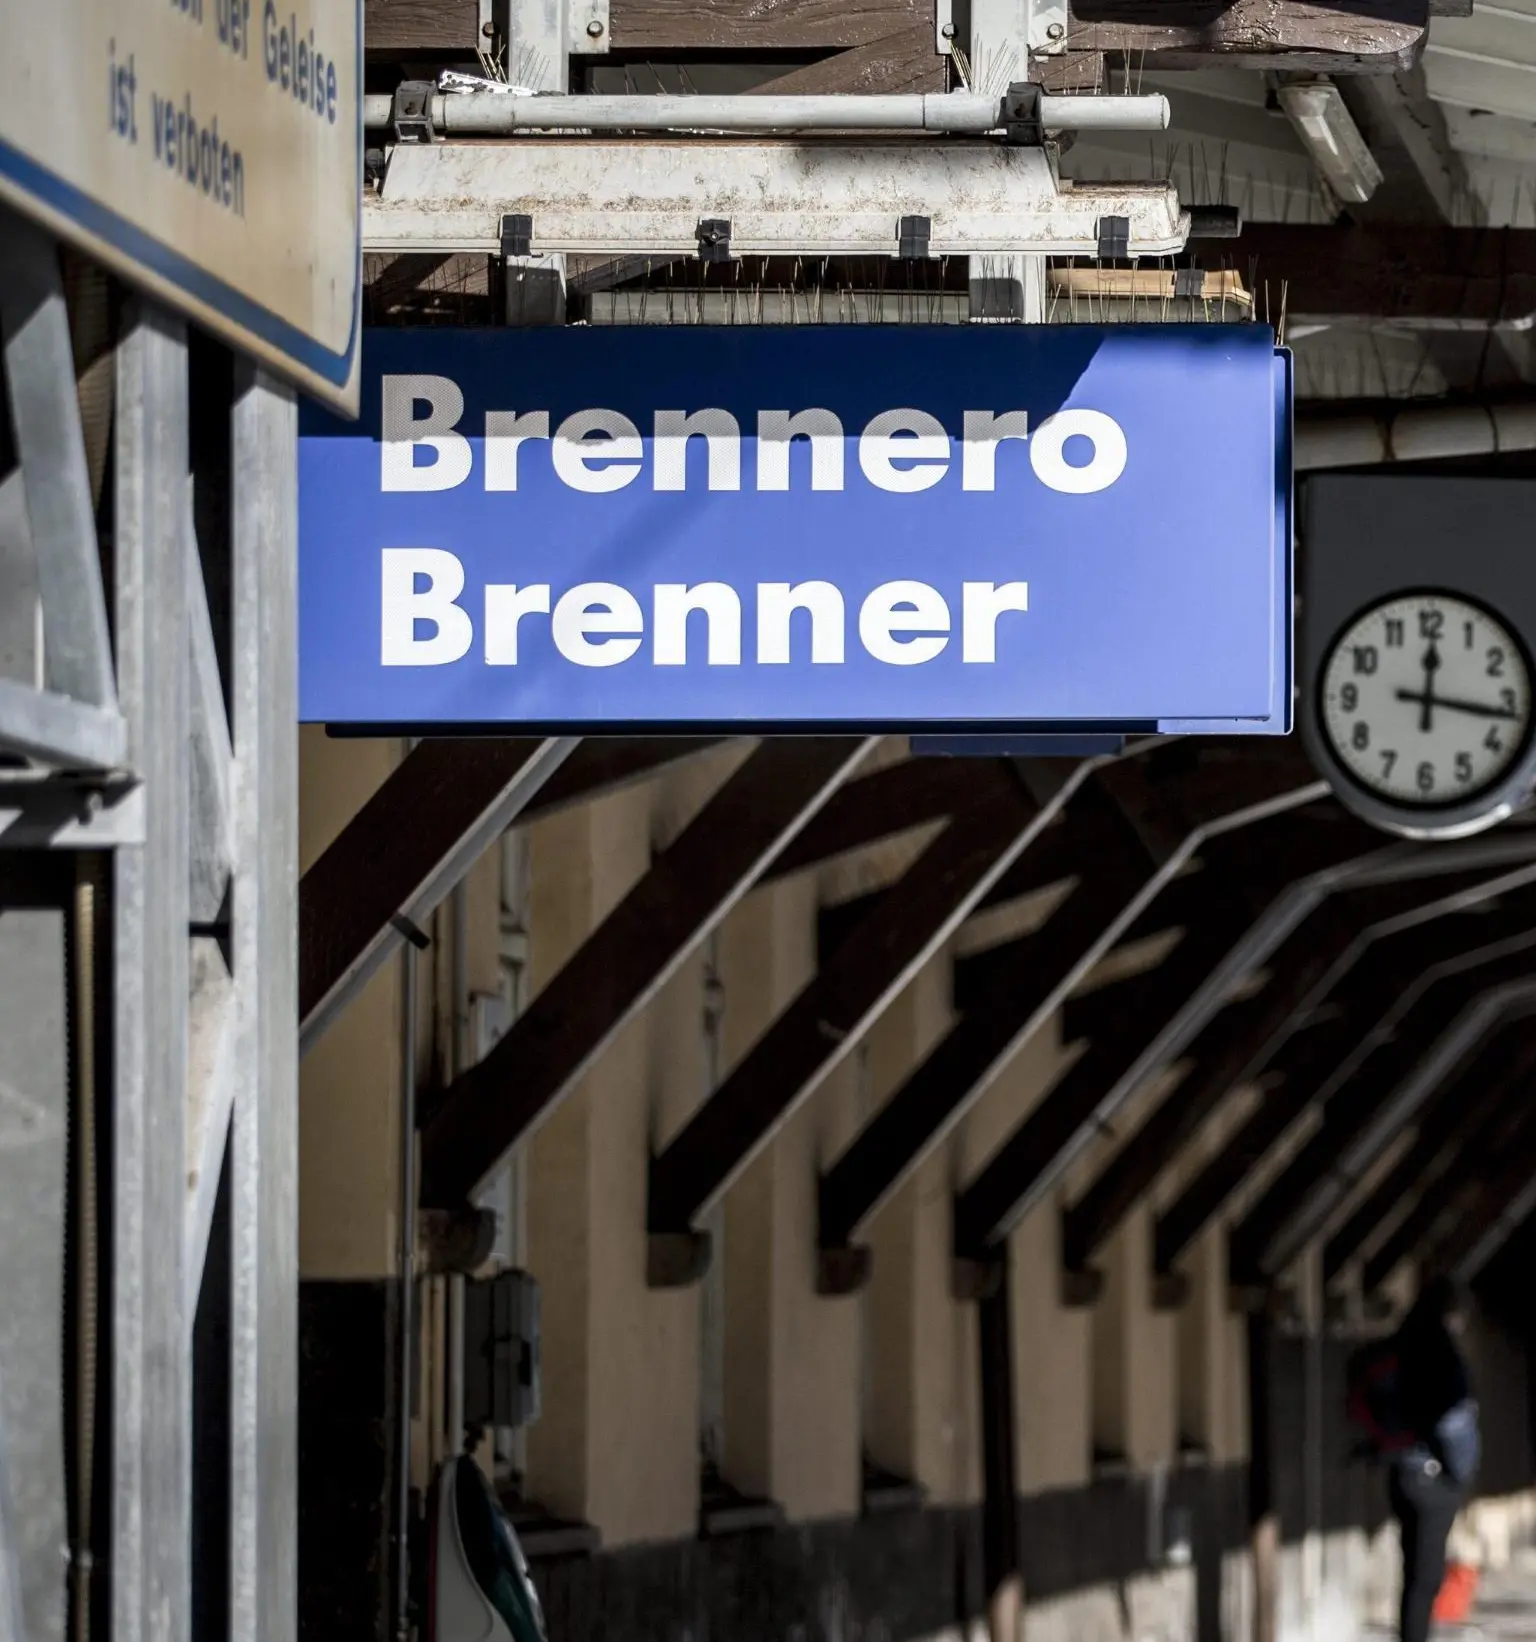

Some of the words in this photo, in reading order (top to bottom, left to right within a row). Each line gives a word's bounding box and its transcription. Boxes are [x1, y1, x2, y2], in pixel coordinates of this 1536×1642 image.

[264, 0, 337, 124] Geleise
[109, 38, 137, 144] ist
[152, 91, 246, 218] verboten
[381, 374, 1128, 494] Brennero
[381, 547, 1028, 666] Brenner
[1385, 618, 1404, 647] 11
[1418, 609, 1444, 640] 12
[1463, 620, 1474, 649] 1
[1353, 645, 1378, 676] 10
[1486, 646, 1505, 677] 2
[1340, 682, 1358, 713] 9
[1352, 721, 1369, 751] 8
[1483, 725, 1502, 754] 4
[1380, 750, 1397, 779] 7
[1416, 761, 1434, 791] 6
[1455, 752, 1473, 783] 5
